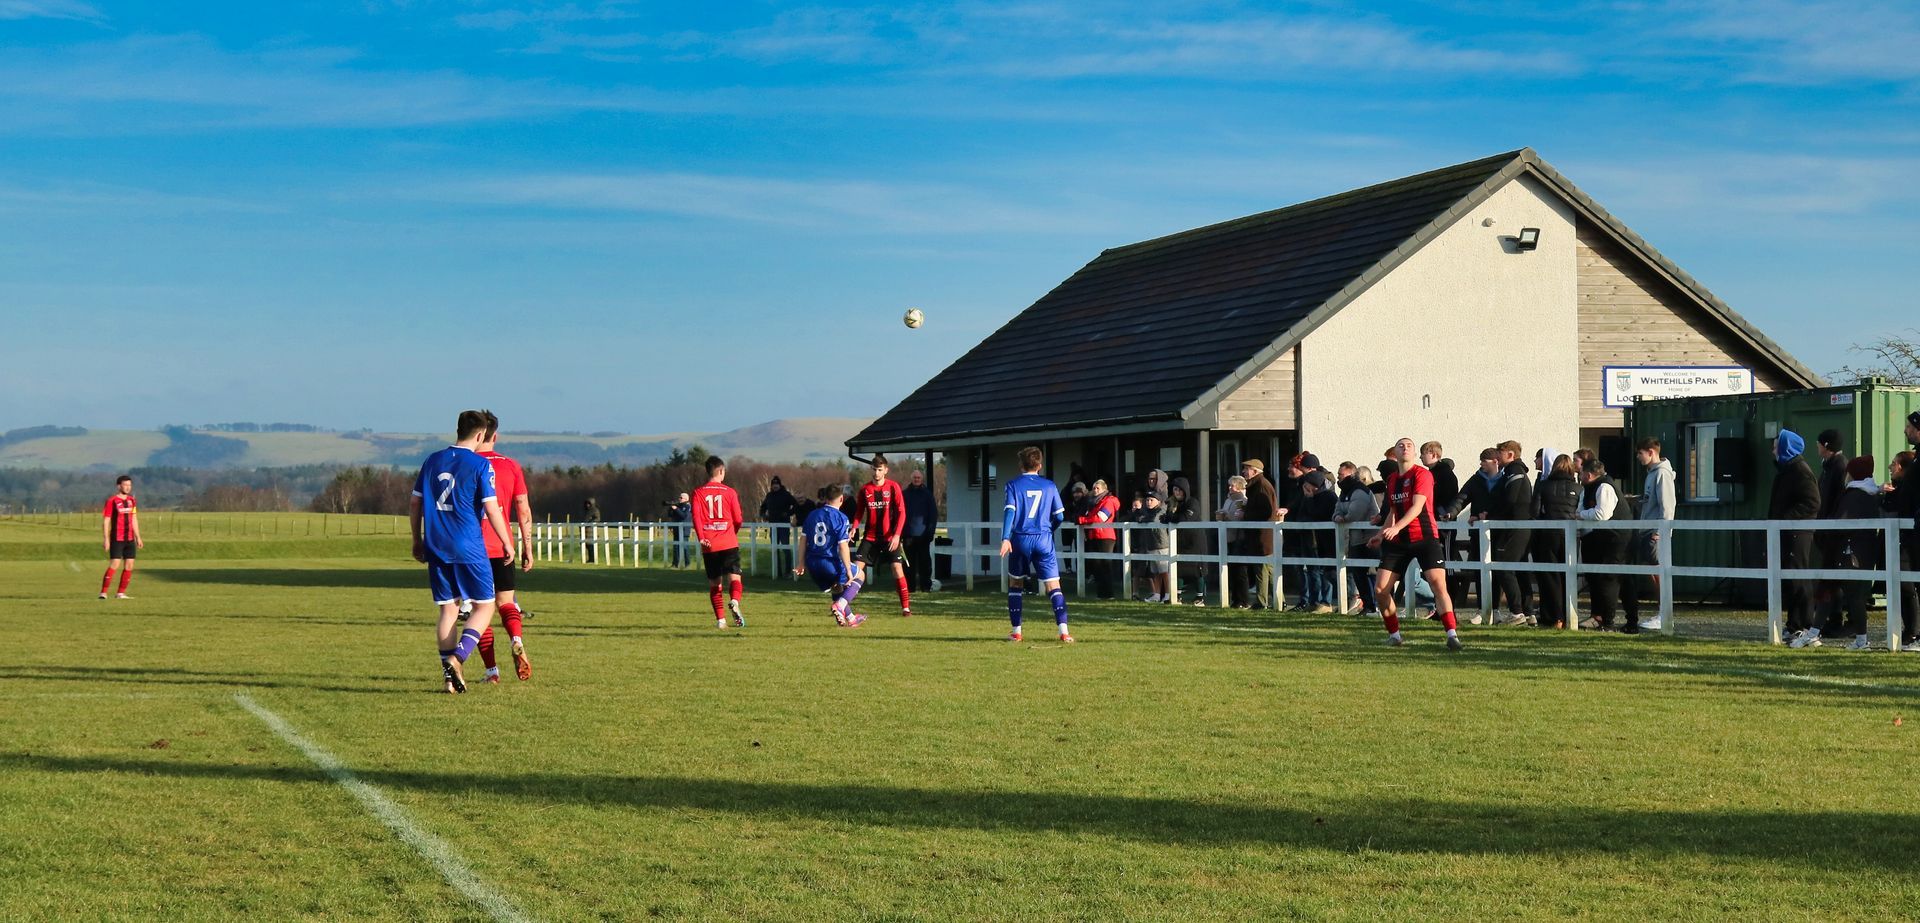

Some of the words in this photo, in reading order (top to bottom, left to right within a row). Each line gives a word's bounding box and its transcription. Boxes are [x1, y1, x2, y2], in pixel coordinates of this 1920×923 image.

[436, 472, 455, 512] 2
[1027, 490, 1043, 519] 7
[705, 494, 723, 519] 11
[814, 521, 827, 547] 8
